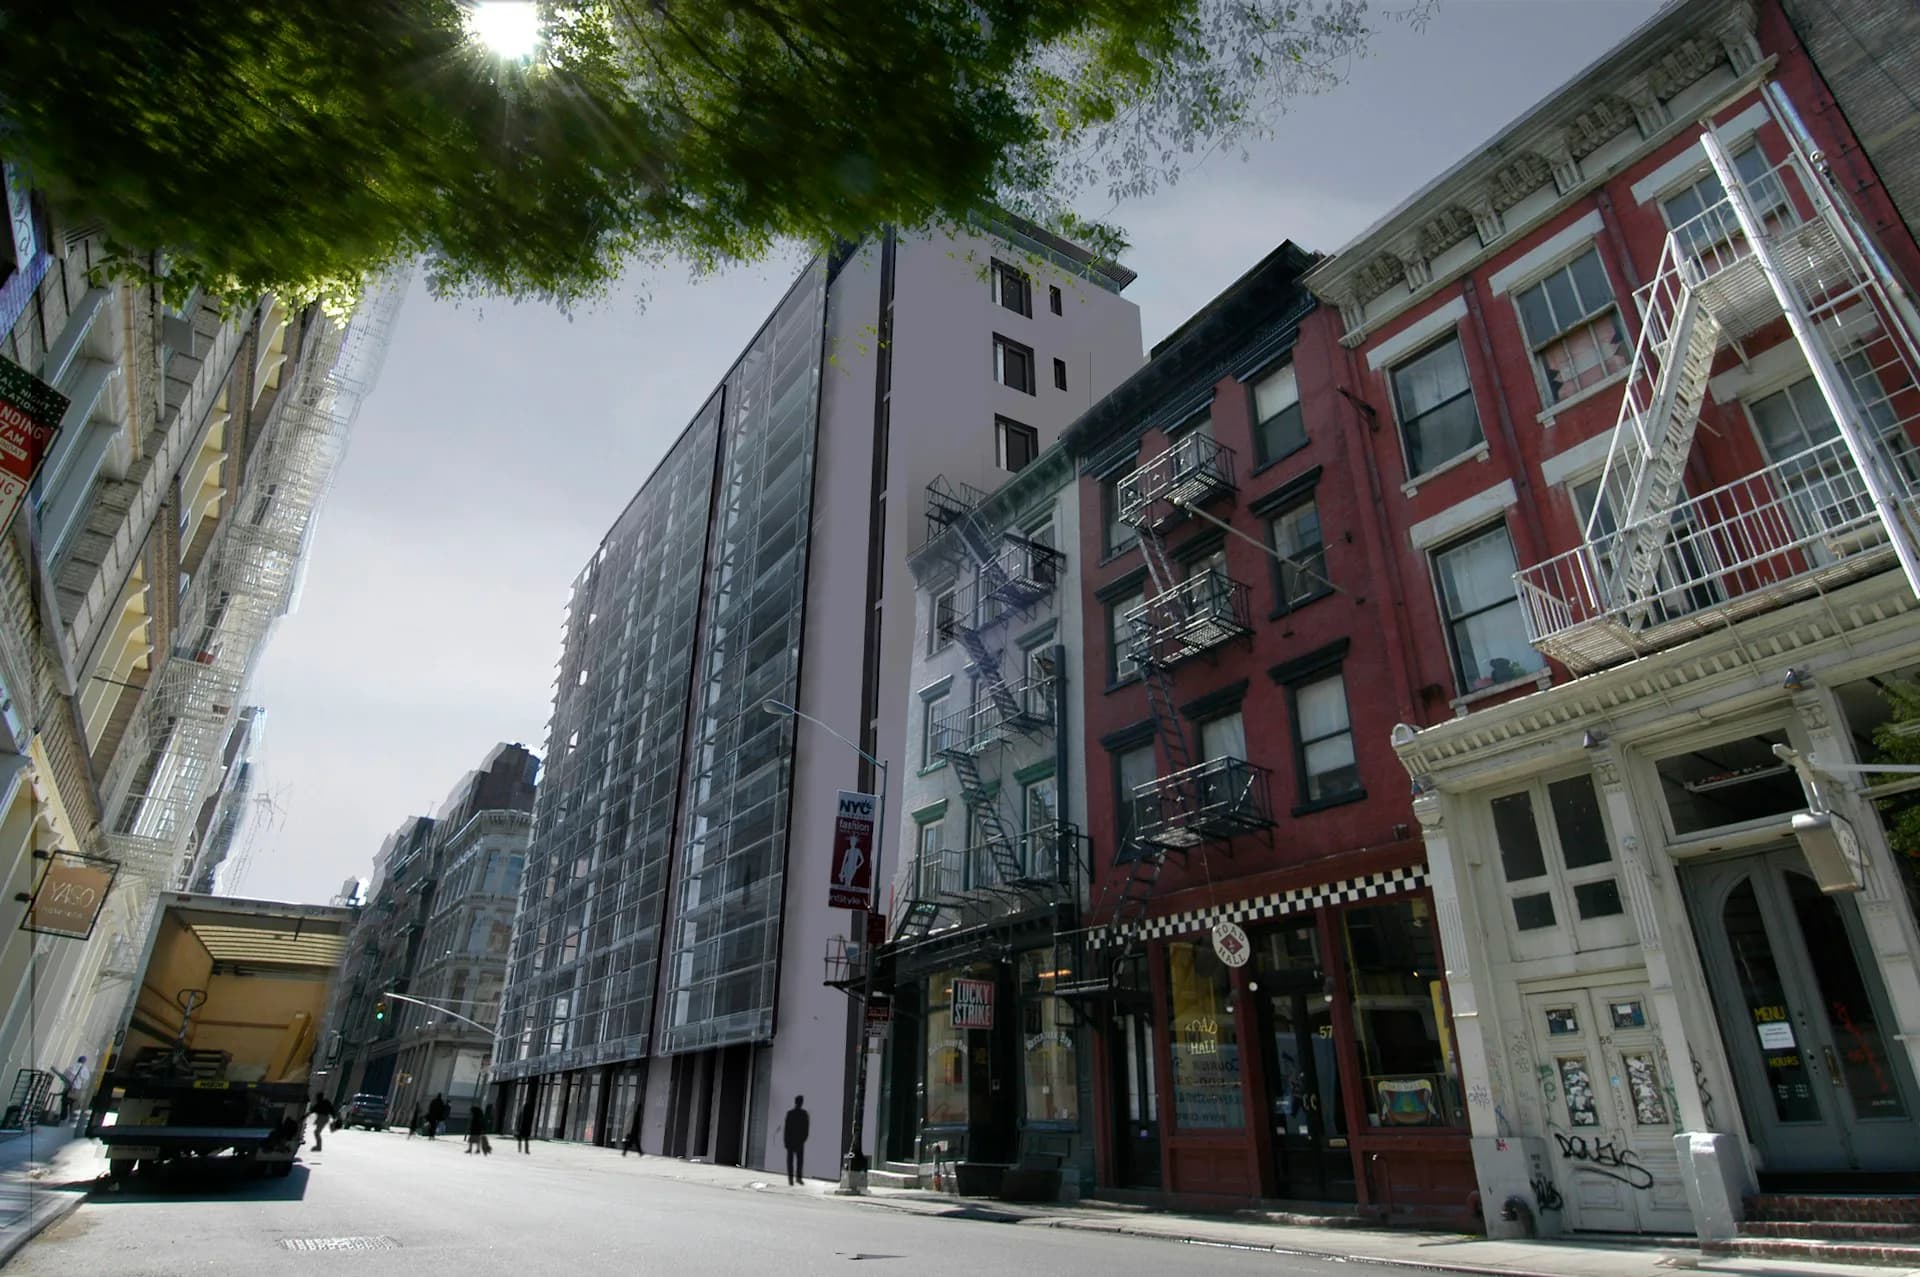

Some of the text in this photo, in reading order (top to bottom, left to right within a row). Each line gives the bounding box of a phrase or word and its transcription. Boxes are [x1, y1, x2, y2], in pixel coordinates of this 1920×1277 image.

[840, 799, 873, 815] NYC
[840, 818, 870, 833] fashion
[1216, 924, 1245, 942] TOAD
[1218, 947, 1247, 965] HALL
[957, 982, 990, 1005] LUCKY
[954, 1003, 991, 1026] STRIKE
[1755, 1006, 1786, 1021] MENU
[1319, 1025, 1333, 1039] 57
[1189, 1039, 1216, 1055] HALL
[1769, 1056, 1799, 1068] HOURS
